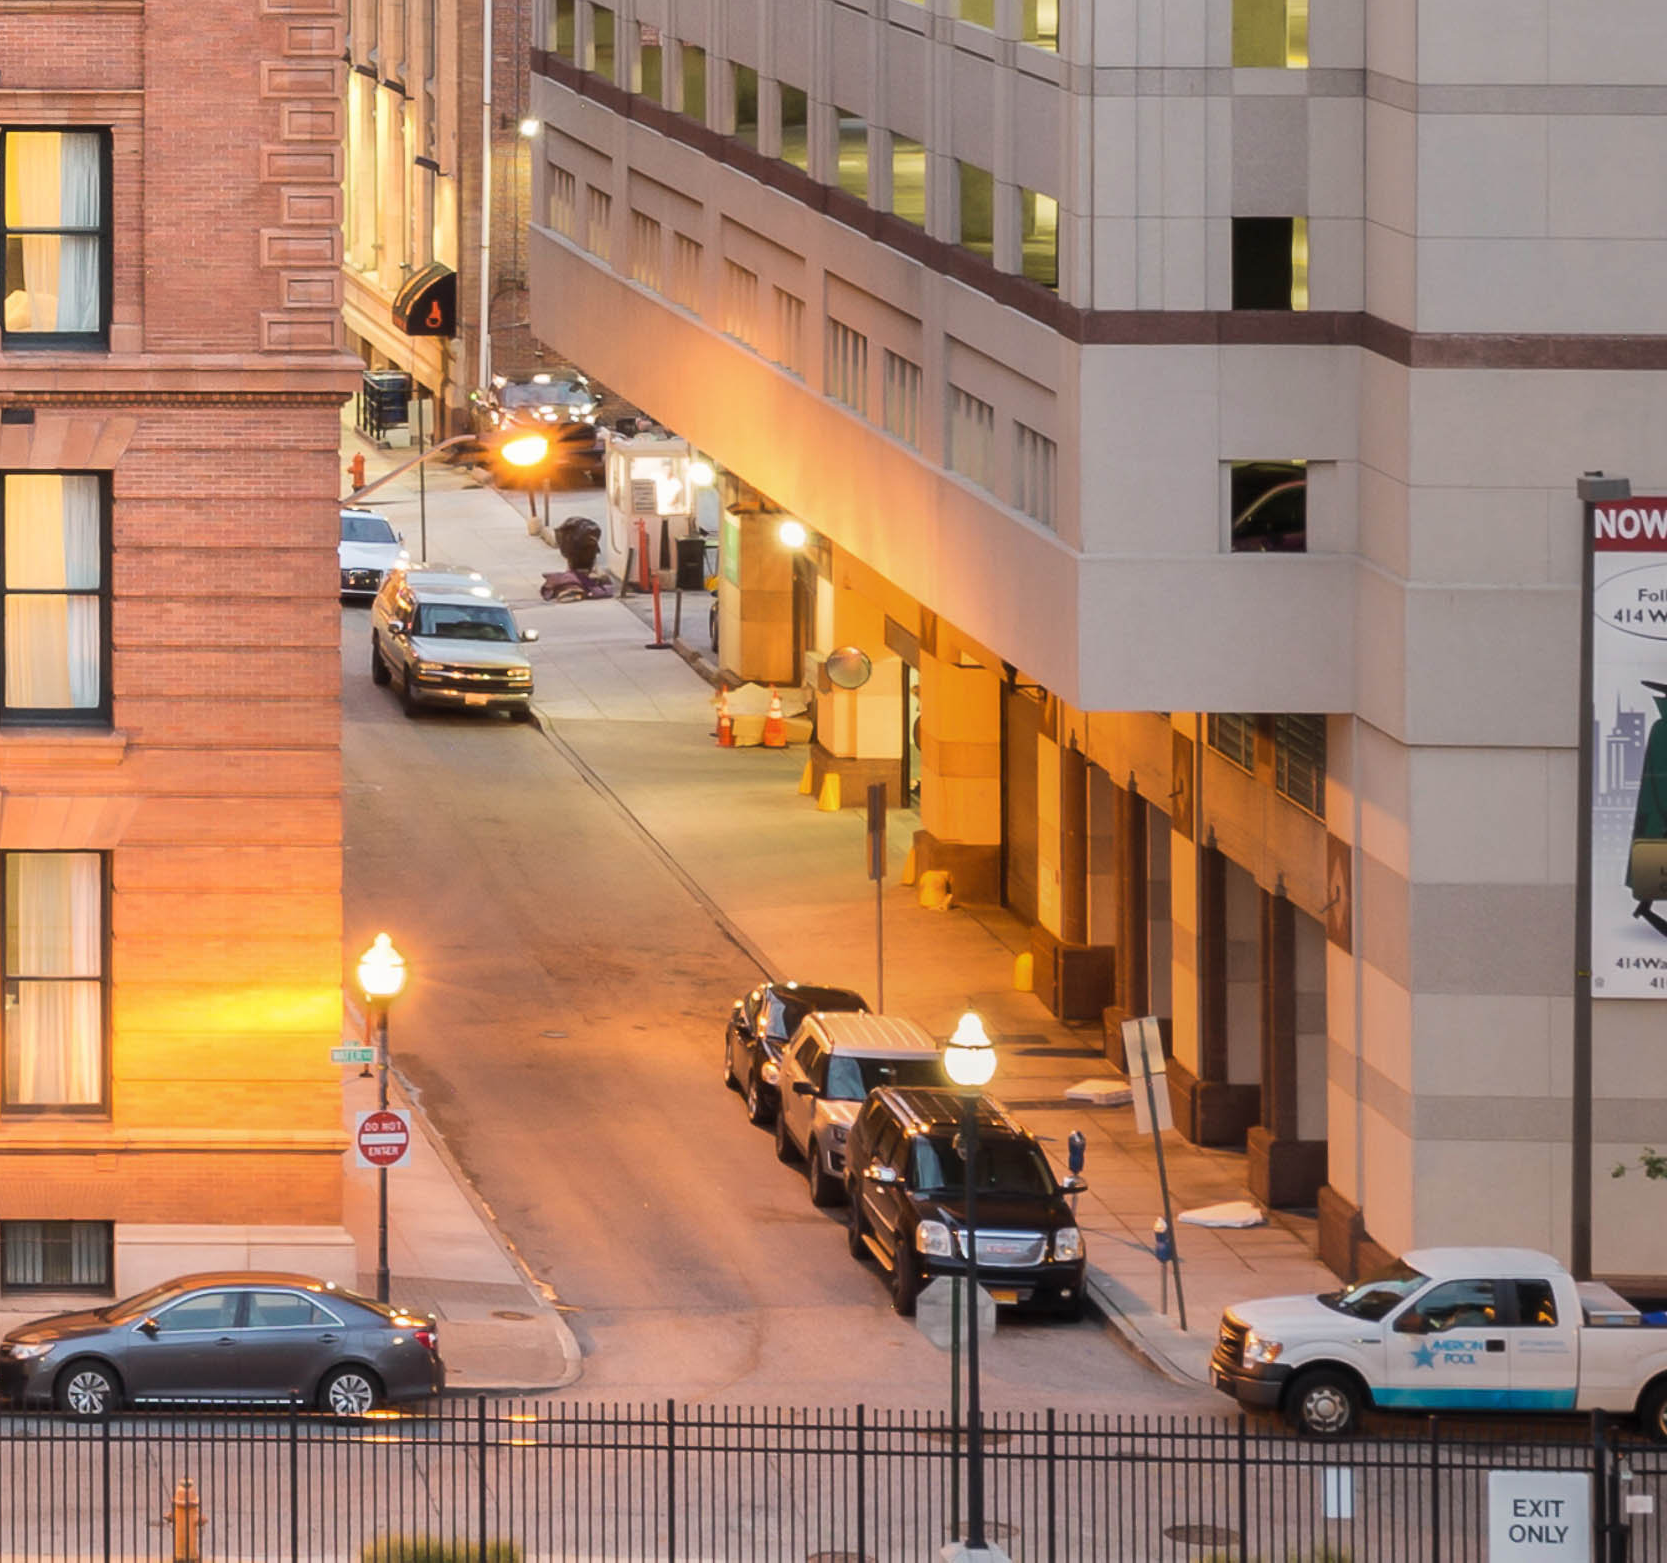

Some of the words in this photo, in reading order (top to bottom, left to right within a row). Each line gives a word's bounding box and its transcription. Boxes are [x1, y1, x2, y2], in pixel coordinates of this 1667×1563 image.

[1594, 508, 1667, 539] NOW
[1613, 608, 1643, 623] 414
[364, 1121, 379, 1132] DO
[381, 1120, 402, 1132] NOT
[368, 1145, 400, 1157] ENTER
[1513, 1499, 1565, 1518] EXIT
[1509, 1524, 1569, 1543] ONLY
